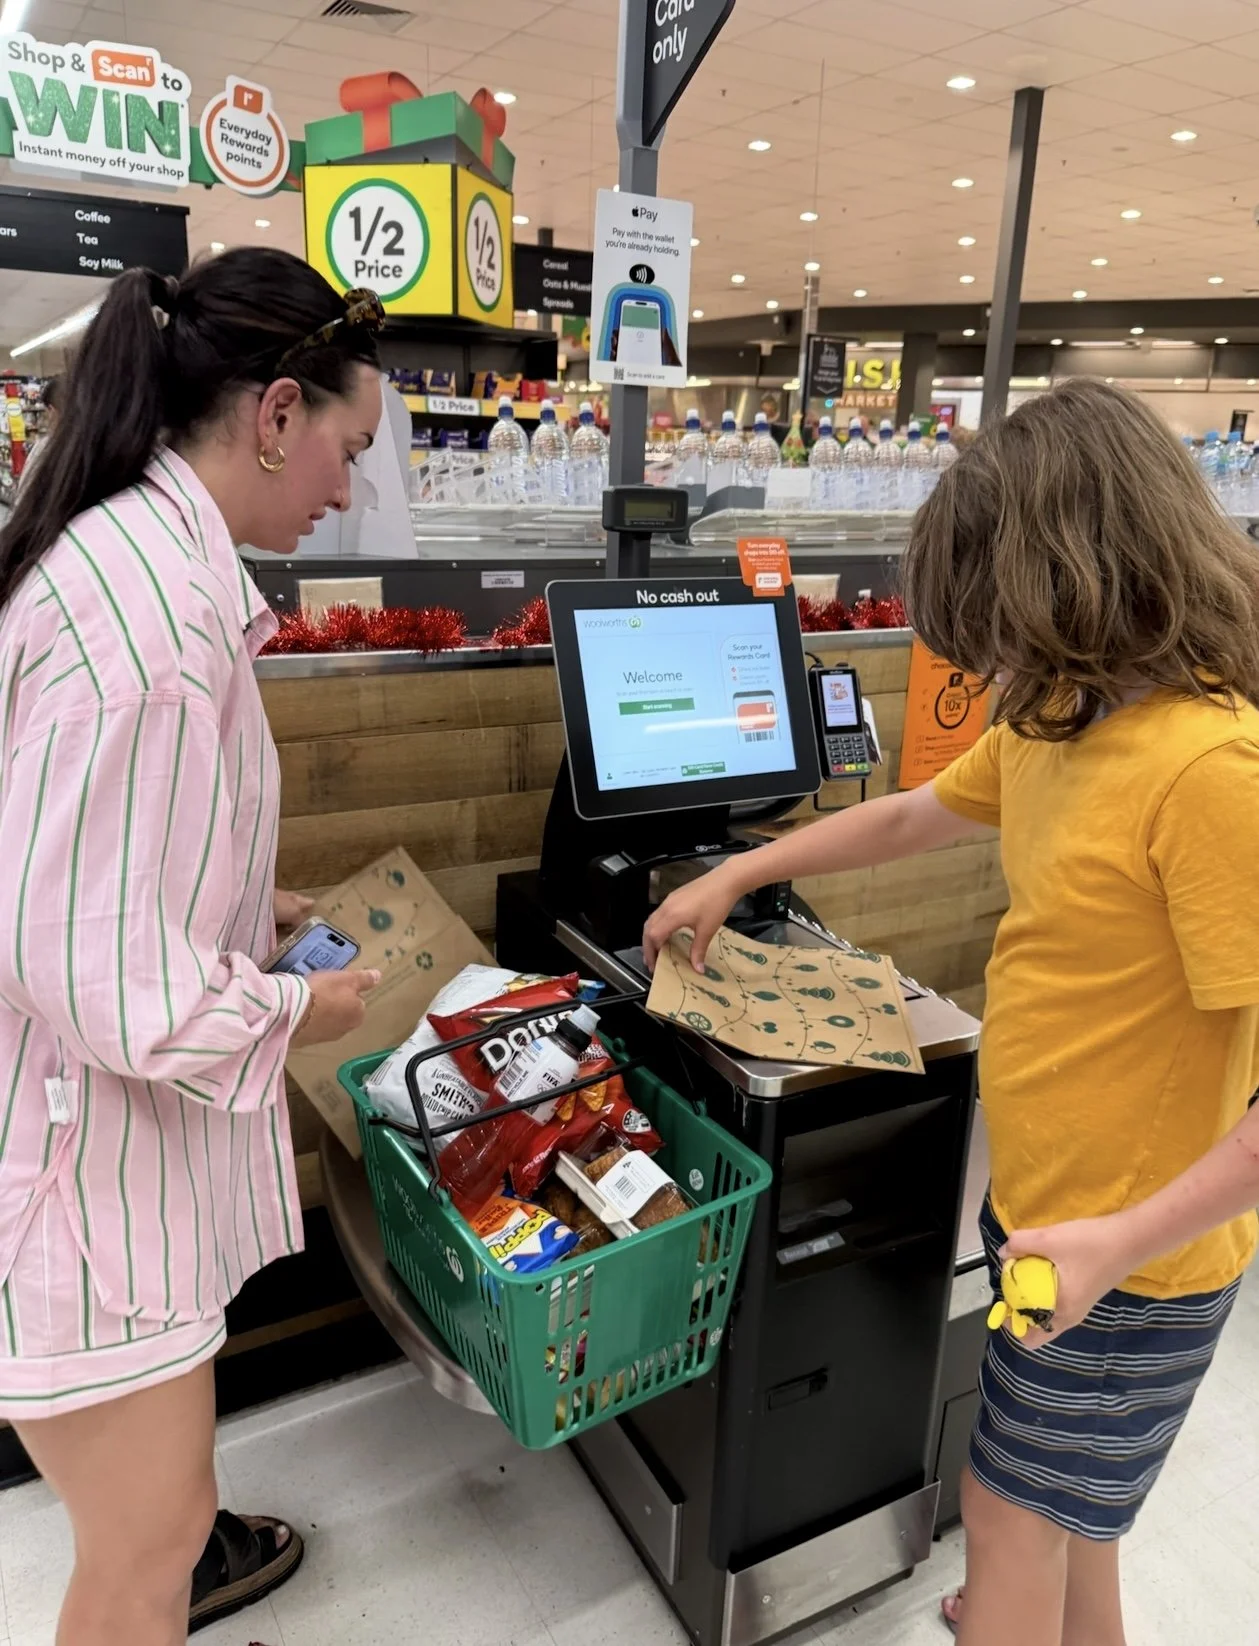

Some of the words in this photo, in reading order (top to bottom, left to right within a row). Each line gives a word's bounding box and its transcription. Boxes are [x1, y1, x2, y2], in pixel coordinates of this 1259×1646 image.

[653, 23, 688, 64] only
[8, 41, 65, 73] Shop
[71, 53, 86, 72] &
[98, 56, 150, 81] Scan
[161, 73, 183, 91] to
[219, 118, 272, 146] Everyday
[220, 133, 269, 157] Rewards
[19, 141, 63, 158] Instant
[66, 152, 107, 168] money
[109, 157, 126, 168] off
[129, 161, 154, 173] your
[157, 164, 184, 180] shop
[226, 151, 262, 169] points
[75, 209, 111, 223] Coffee
[640, 207, 658, 223] Pay
[0, 227, 17, 237] ars
[76, 232, 98, 245] Tea
[349, 206, 405, 256] 1/2
[612, 227, 626, 238] Pay
[626, 230, 641, 239] with
[642, 232, 654, 240] the
[655, 235, 675, 243] wallet
[474, 216, 495, 270] 1/2
[605, 240, 626, 248] you're
[627, 242, 653, 254] already
[79, 256, 100, 270] Soy
[101, 258, 124, 270] Milk
[354, 259, 403, 278] Price
[543, 259, 569, 270] Cereal
[476, 267, 496, 291] Price
[543, 278, 561, 289] Oats
[570, 281, 592, 291] Muesl
[543, 297, 574, 309] Spreads
[449, 402, 474, 412] Price
[636, 590, 657, 604] No
[660, 589, 693, 603] cash
[696, 589, 719, 602] out
[623, 670, 683, 684] Welcome
[945, 700, 961, 711] 10x
[542, 1072, 560, 1087] FIFA
